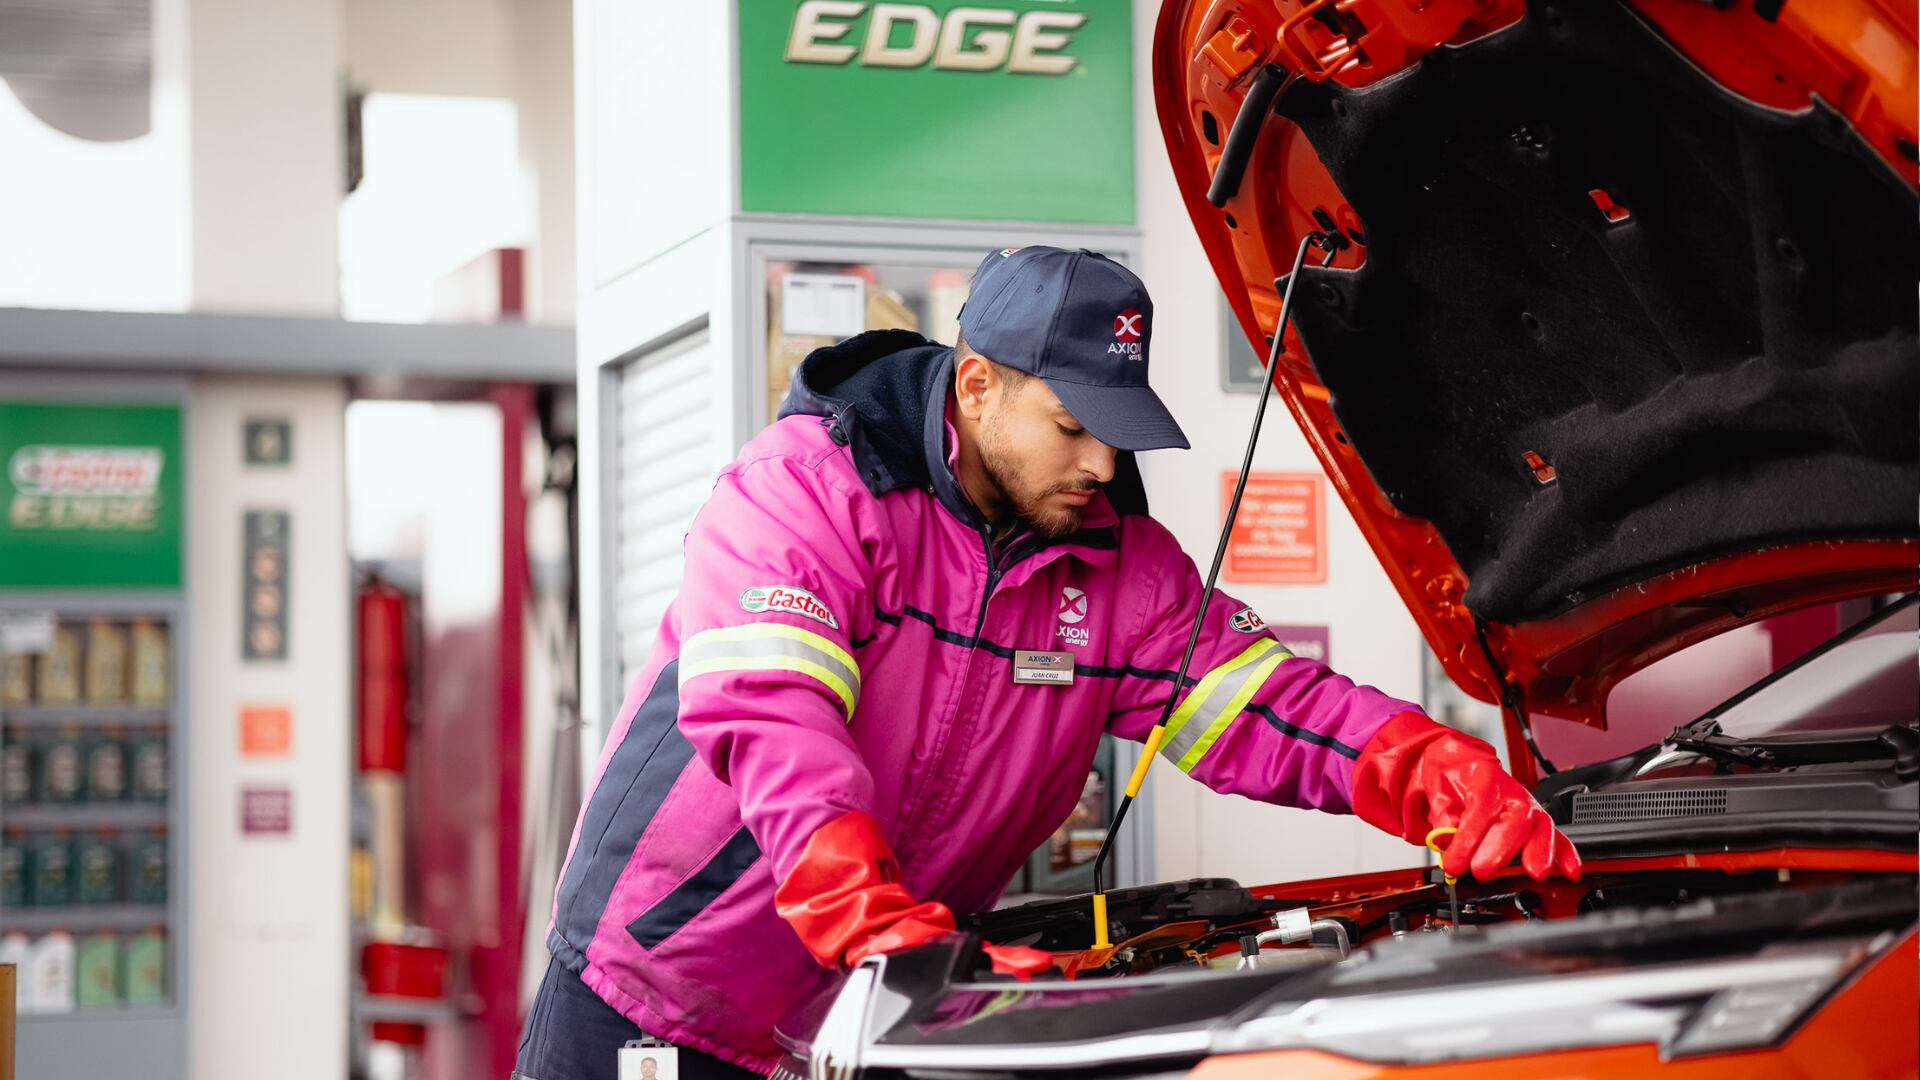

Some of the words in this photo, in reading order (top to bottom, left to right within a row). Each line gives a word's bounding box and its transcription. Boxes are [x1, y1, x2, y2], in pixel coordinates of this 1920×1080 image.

[784, 0, 1088, 76] EDGE
[1107, 343, 1142, 354] AXION
[768, 589, 834, 624] Castrol
